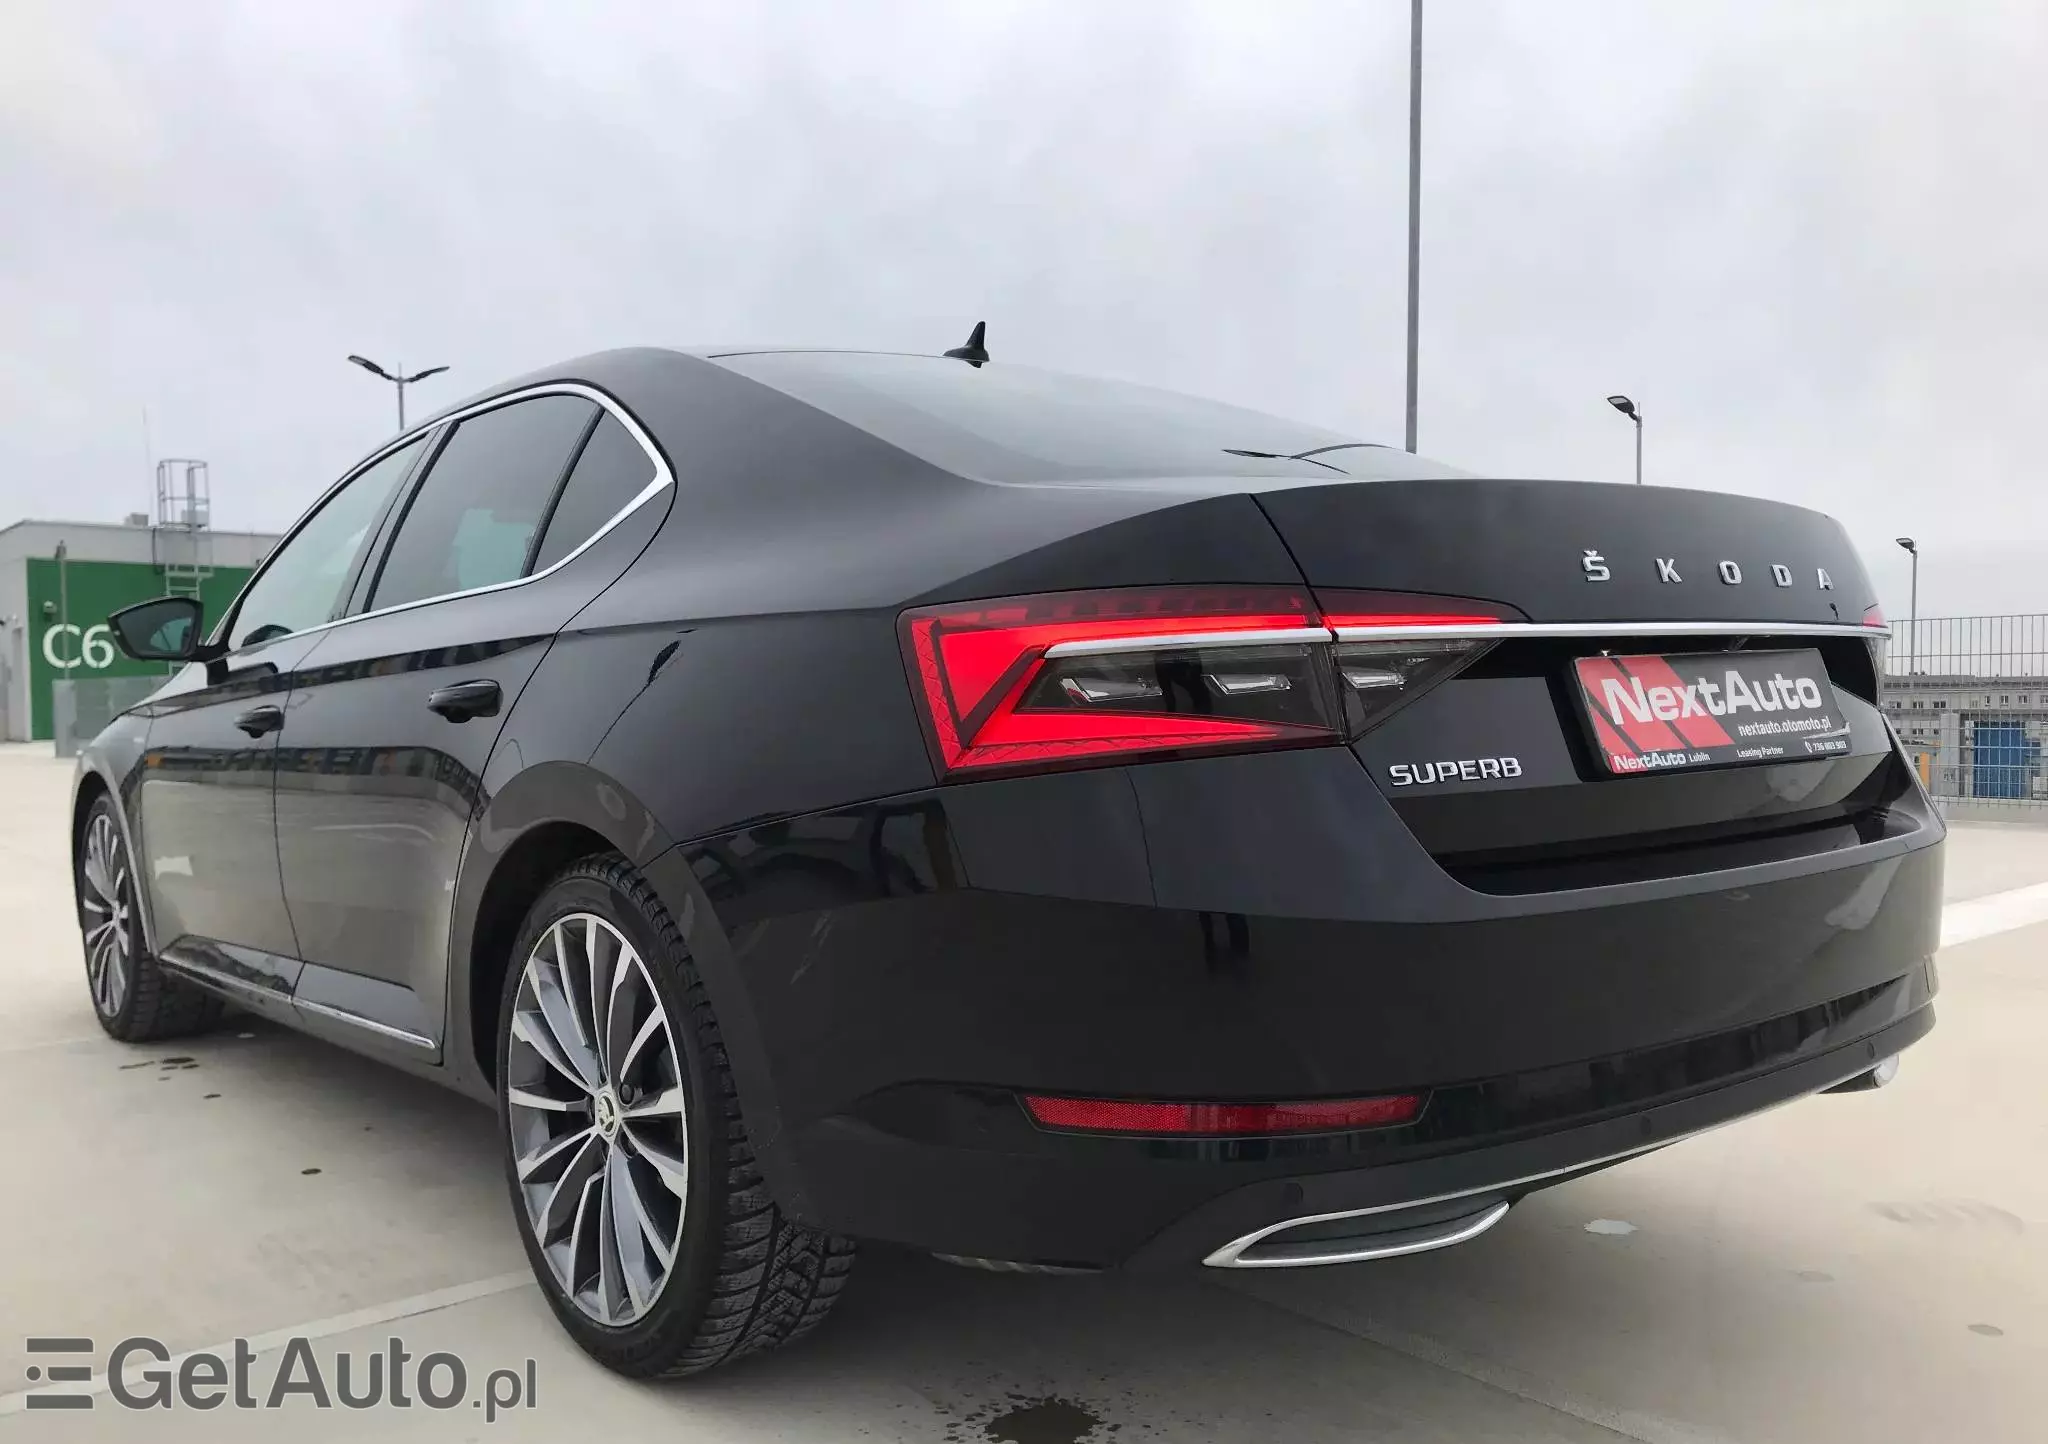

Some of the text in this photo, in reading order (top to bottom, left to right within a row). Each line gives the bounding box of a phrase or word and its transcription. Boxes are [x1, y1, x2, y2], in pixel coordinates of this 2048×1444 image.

[42, 624, 115, 669] C6
[1601, 670, 1823, 726] NextAuto
[1737, 716, 1832, 737] nextauto.otomoto.pl
[1613, 752, 1711, 770] NextAuto Lublin
[1761, 746, 1784, 756] Partner
[1389, 757, 1523, 786] SUPERB
